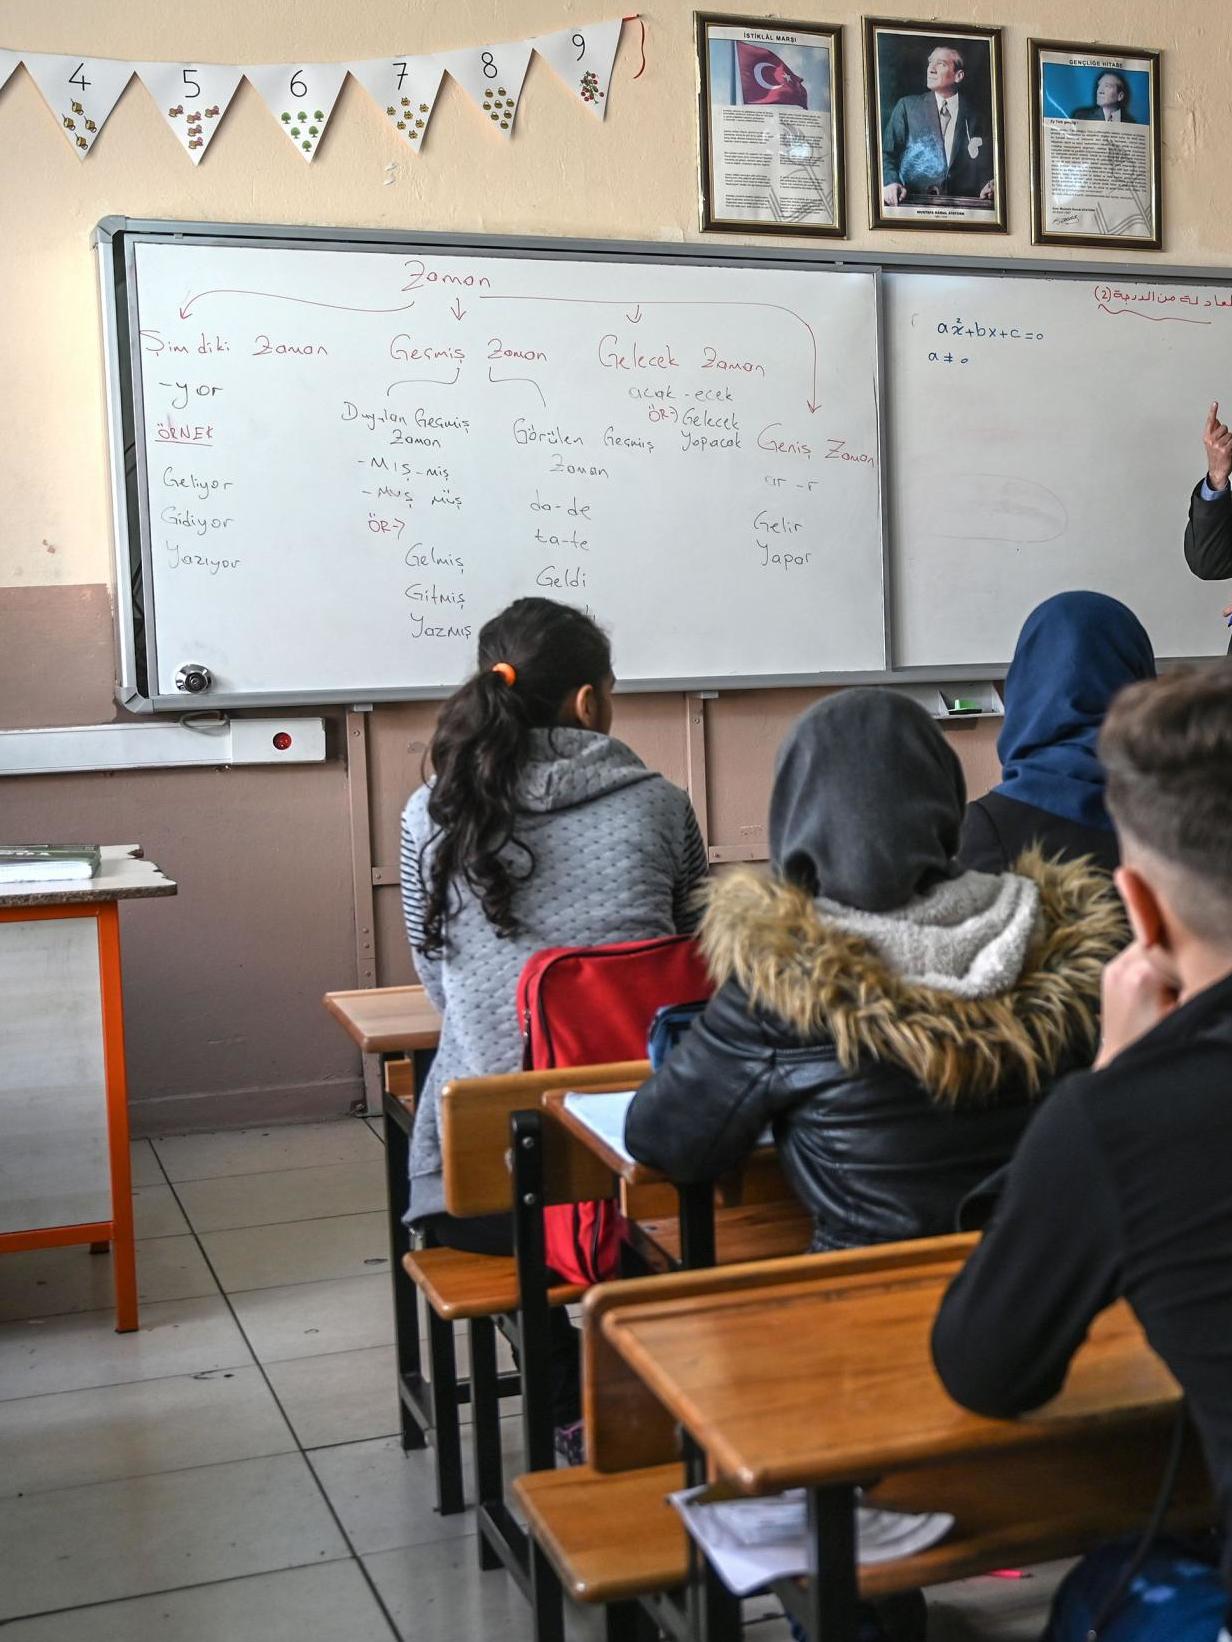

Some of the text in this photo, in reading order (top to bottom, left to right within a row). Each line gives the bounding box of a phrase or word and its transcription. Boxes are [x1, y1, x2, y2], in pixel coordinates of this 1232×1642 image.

[572, 34, 585, 60] 9
[68, 64, 92, 92] 4
[392, 63, 408, 90] 7
[482, 52, 498, 78] 8
[184, 70, 200, 98] 5
[291, 70, 307, 97] 6
[161, 506, 235, 535] Gidiyor
[753, 510, 802, 534] Gelir
[536, 566, 588, 589] Geldi
